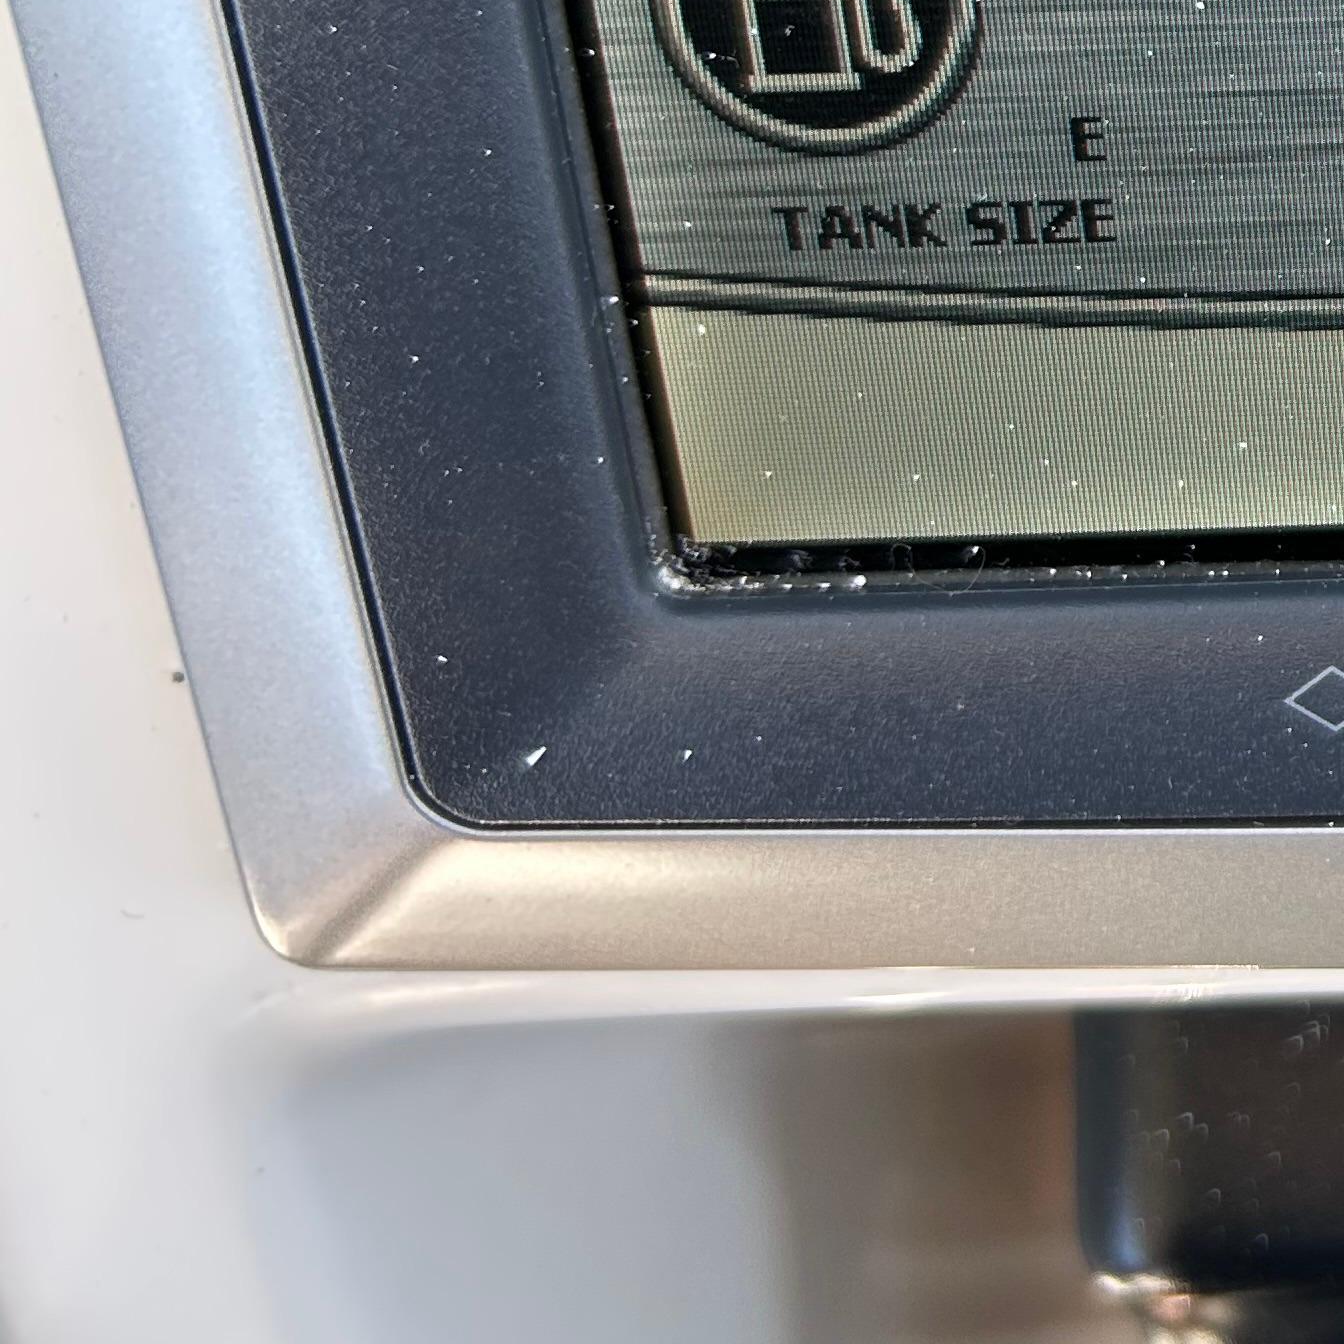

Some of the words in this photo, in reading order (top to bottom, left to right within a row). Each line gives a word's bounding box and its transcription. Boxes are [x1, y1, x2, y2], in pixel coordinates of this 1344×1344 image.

[1071, 117, 1107, 162] E
[772, 203, 945, 252] TANK
[970, 199, 1117, 246] SIZE
